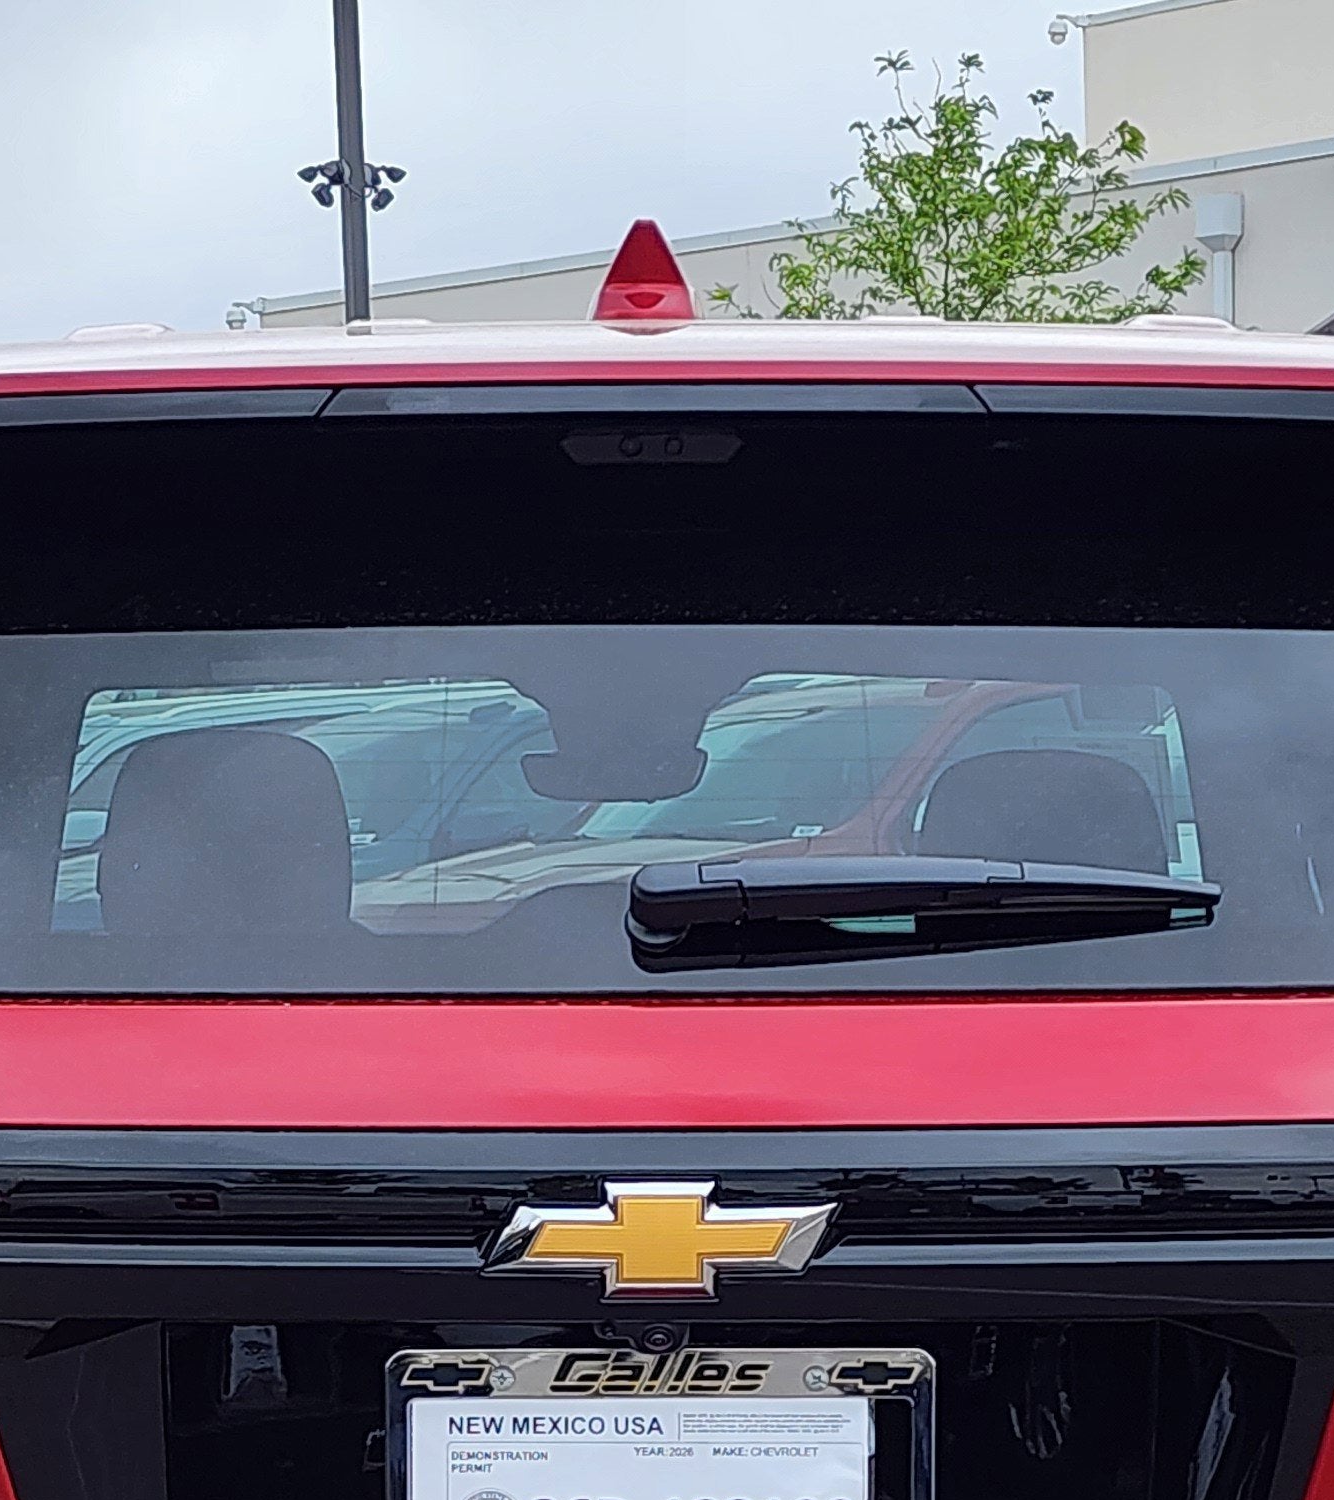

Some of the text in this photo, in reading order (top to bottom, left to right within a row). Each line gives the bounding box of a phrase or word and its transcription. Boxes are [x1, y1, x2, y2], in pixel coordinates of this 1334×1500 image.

[549, 1352, 774, 1394] Galles
[448, 1416, 505, 1435] NEW
[512, 1416, 606, 1435] MEXICO
[614, 1416, 664, 1435] USA
[451, 1451, 548, 1461] DEMONSTRATION
[750, 1447, 819, 1457] CHEVROLET
[451, 1463, 493, 1473] PERMIT
